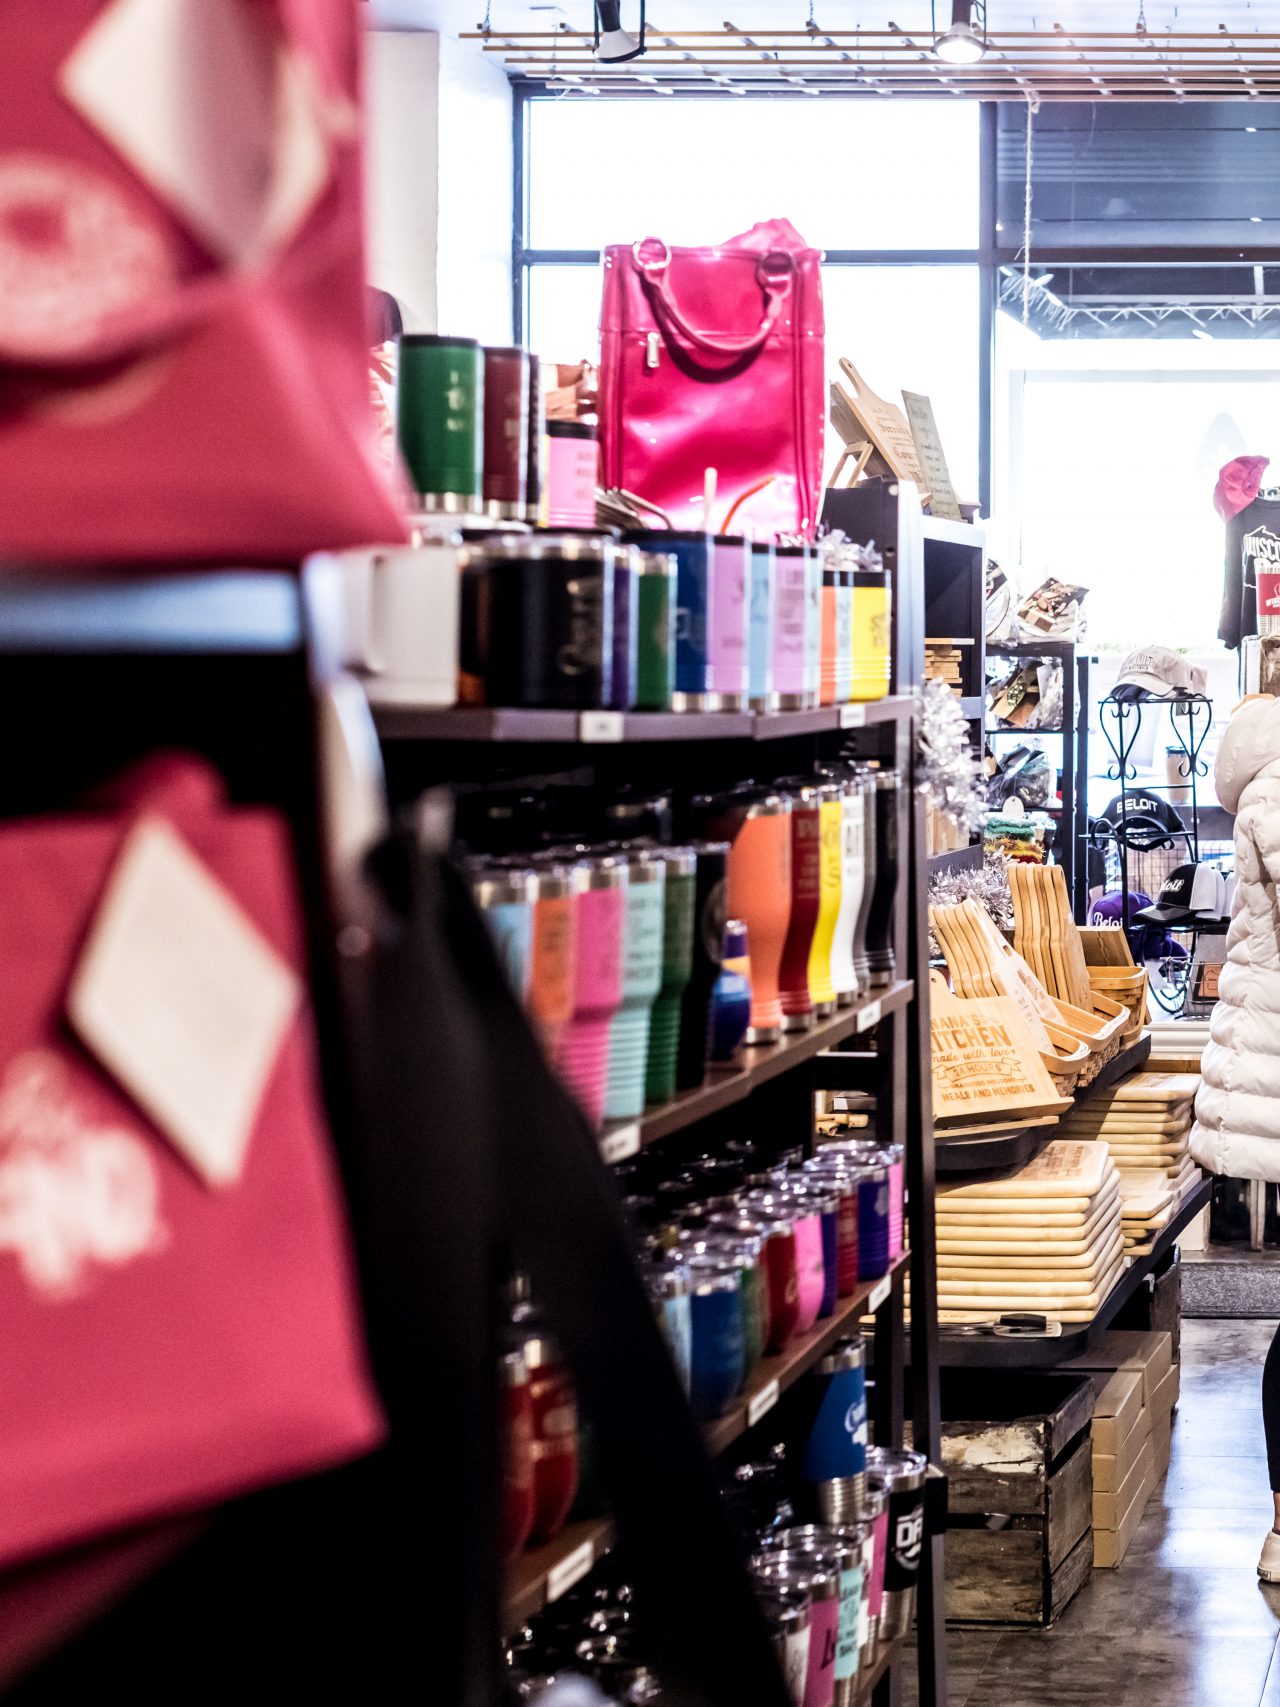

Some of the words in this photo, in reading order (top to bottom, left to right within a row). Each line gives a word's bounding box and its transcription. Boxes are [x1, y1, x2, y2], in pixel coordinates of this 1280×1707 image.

[1116, 798, 1158, 814] BELOIT
[966, 1062, 1002, 1073] HOURS
[973, 1088, 992, 1099] AND
